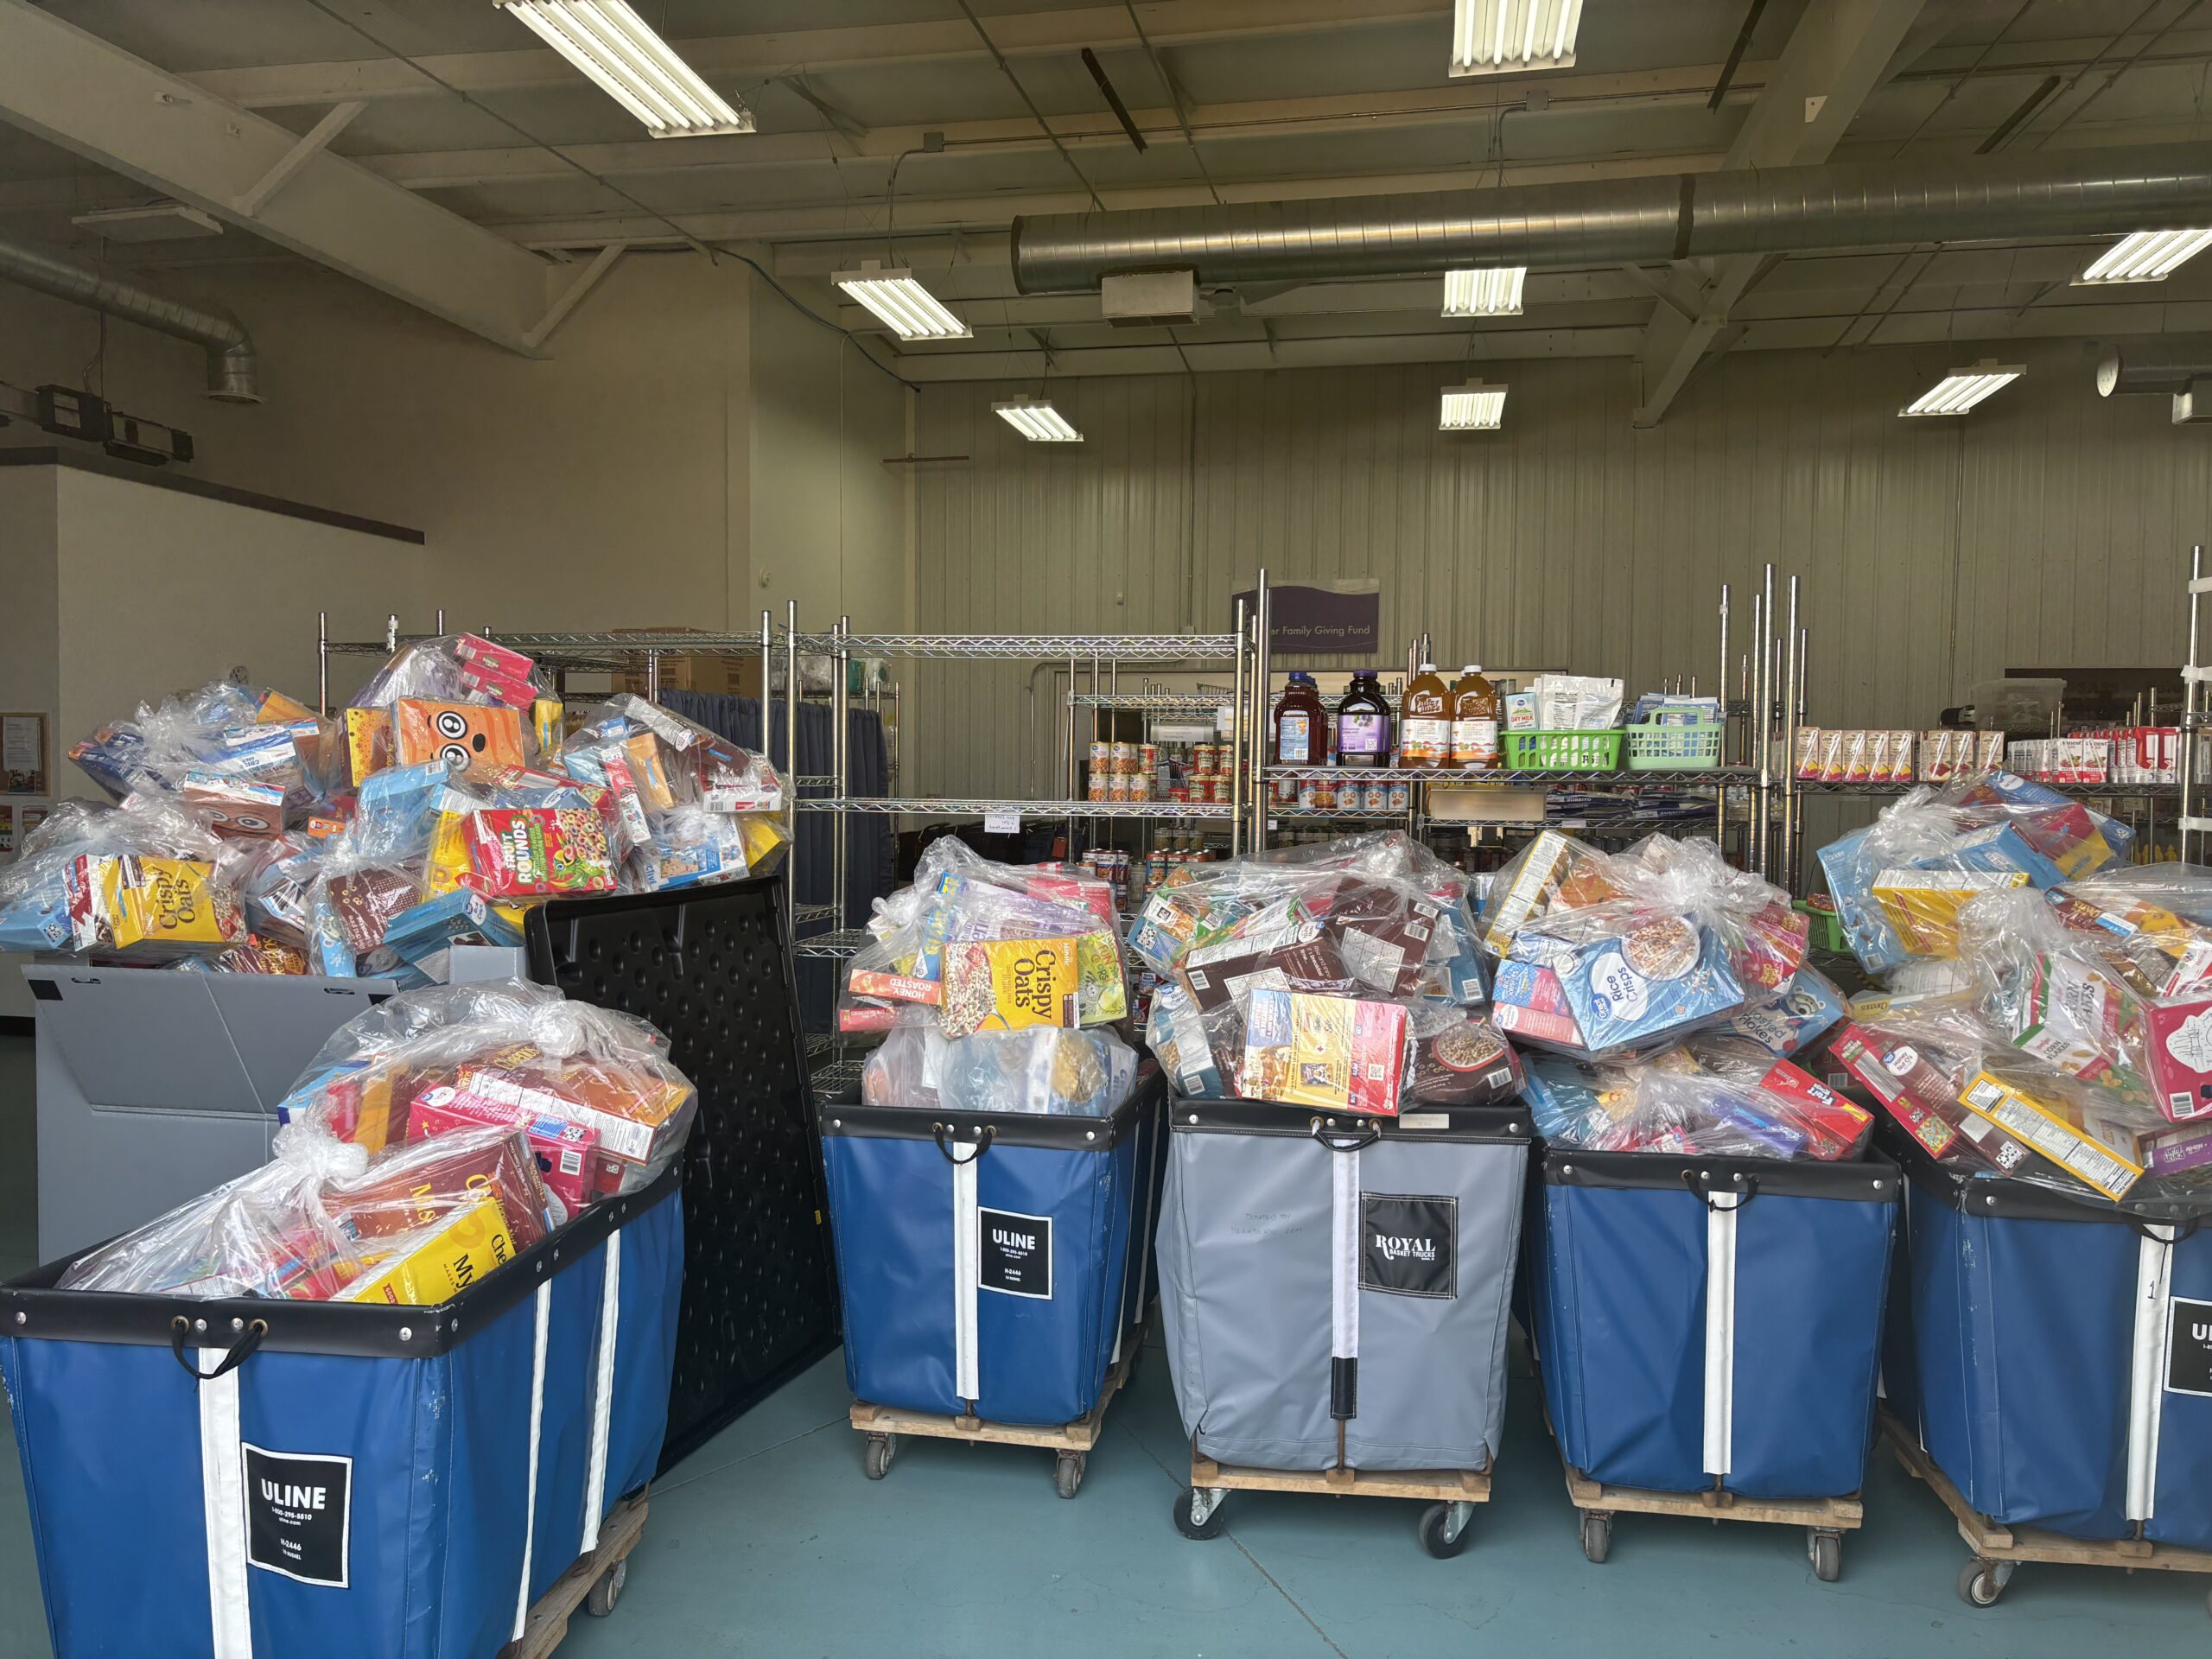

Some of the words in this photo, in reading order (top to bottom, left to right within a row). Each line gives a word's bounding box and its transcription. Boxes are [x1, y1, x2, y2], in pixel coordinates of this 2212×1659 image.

[1282, 626, 1312, 637] Family
[1314, 626, 1344, 637] Giving
[1348, 625, 1370, 635] Fund
[502, 831, 517, 869] FRUIT
[512, 817, 532, 884] ROUNDS
[154, 866, 179, 930] Crispy
[175, 879, 196, 924] Oats
[1064, 942, 1072, 966] Millville
[1099, 944, 1112, 966] FUN
[890, 978, 932, 991] ROASTED
[1014, 957, 1034, 1008] Oats
[1032, 950, 1056, 1020] Crispy
[1607, 976, 1624, 1002] Rice
[1618, 967, 1638, 1002] Crisps
[893, 988, 925, 999] HONEY
[1738, 1012, 1773, 1044] Flakes
[2043, 1039, 2063, 1056] CORN
[2046, 1041, 2071, 1061] FLAKES
[1893, 1051, 1909, 1067] Honey
[1897, 1060, 1906, 1071] Nut
[1808, 1086, 1834, 1106] Fruit
[2164, 1151, 2185, 1163] Raisin
[2166, 1145, 2183, 1155] Bran
[992, 1229, 1035, 1250] ULINE
[1376, 1234, 1435, 1260] ROYAL
[1389, 1249, 1410, 1257] BASKET
[443, 1263, 456, 1287] MAKES
[261, 1478, 327, 1510] ULINE
[271, 1506, 312, 1521] 1-800-295-5510
[278, 1516, 302, 1526] uline.com
[280, 1538, 302, 1551] H-2446
